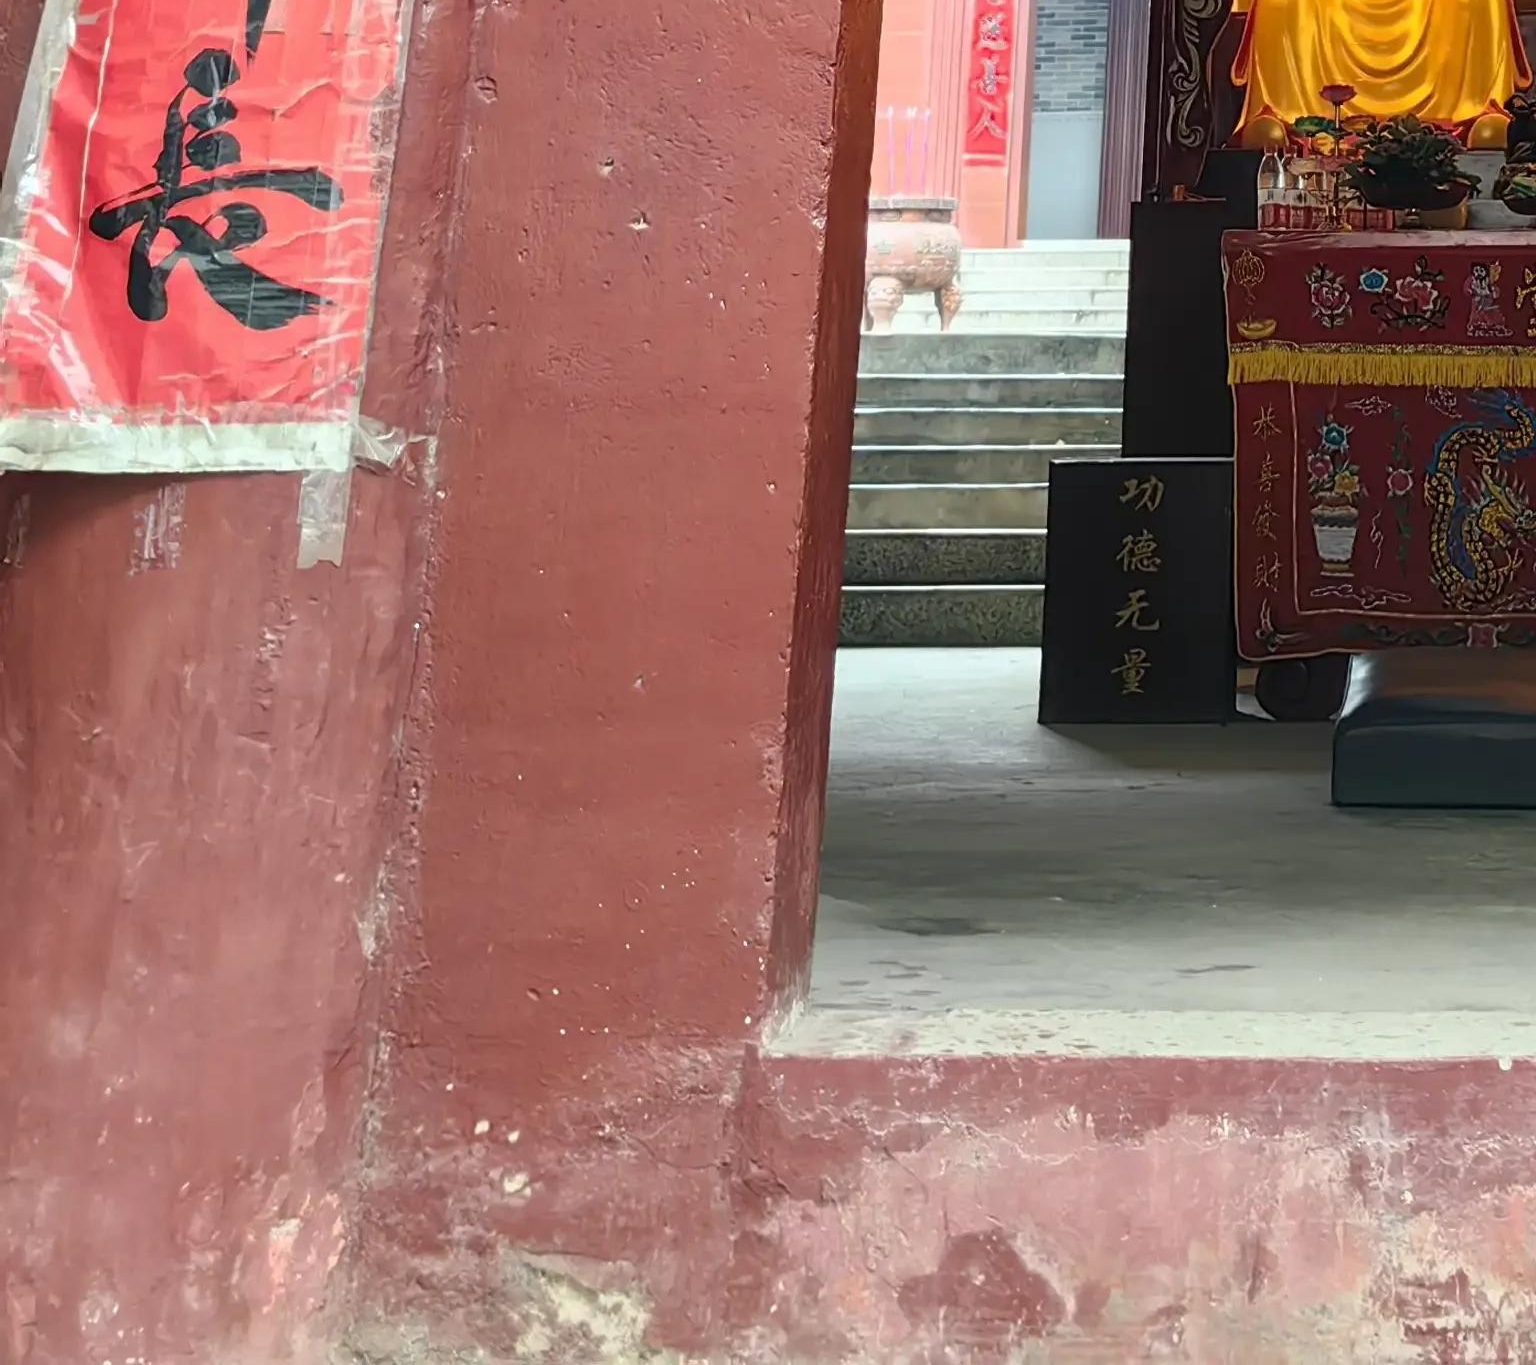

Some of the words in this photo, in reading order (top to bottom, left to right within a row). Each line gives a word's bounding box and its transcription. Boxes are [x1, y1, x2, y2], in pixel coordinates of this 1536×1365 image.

[1111, 474, 1165, 695] 功德无量
[1252, 402, 1283, 593] 恭喜發財
